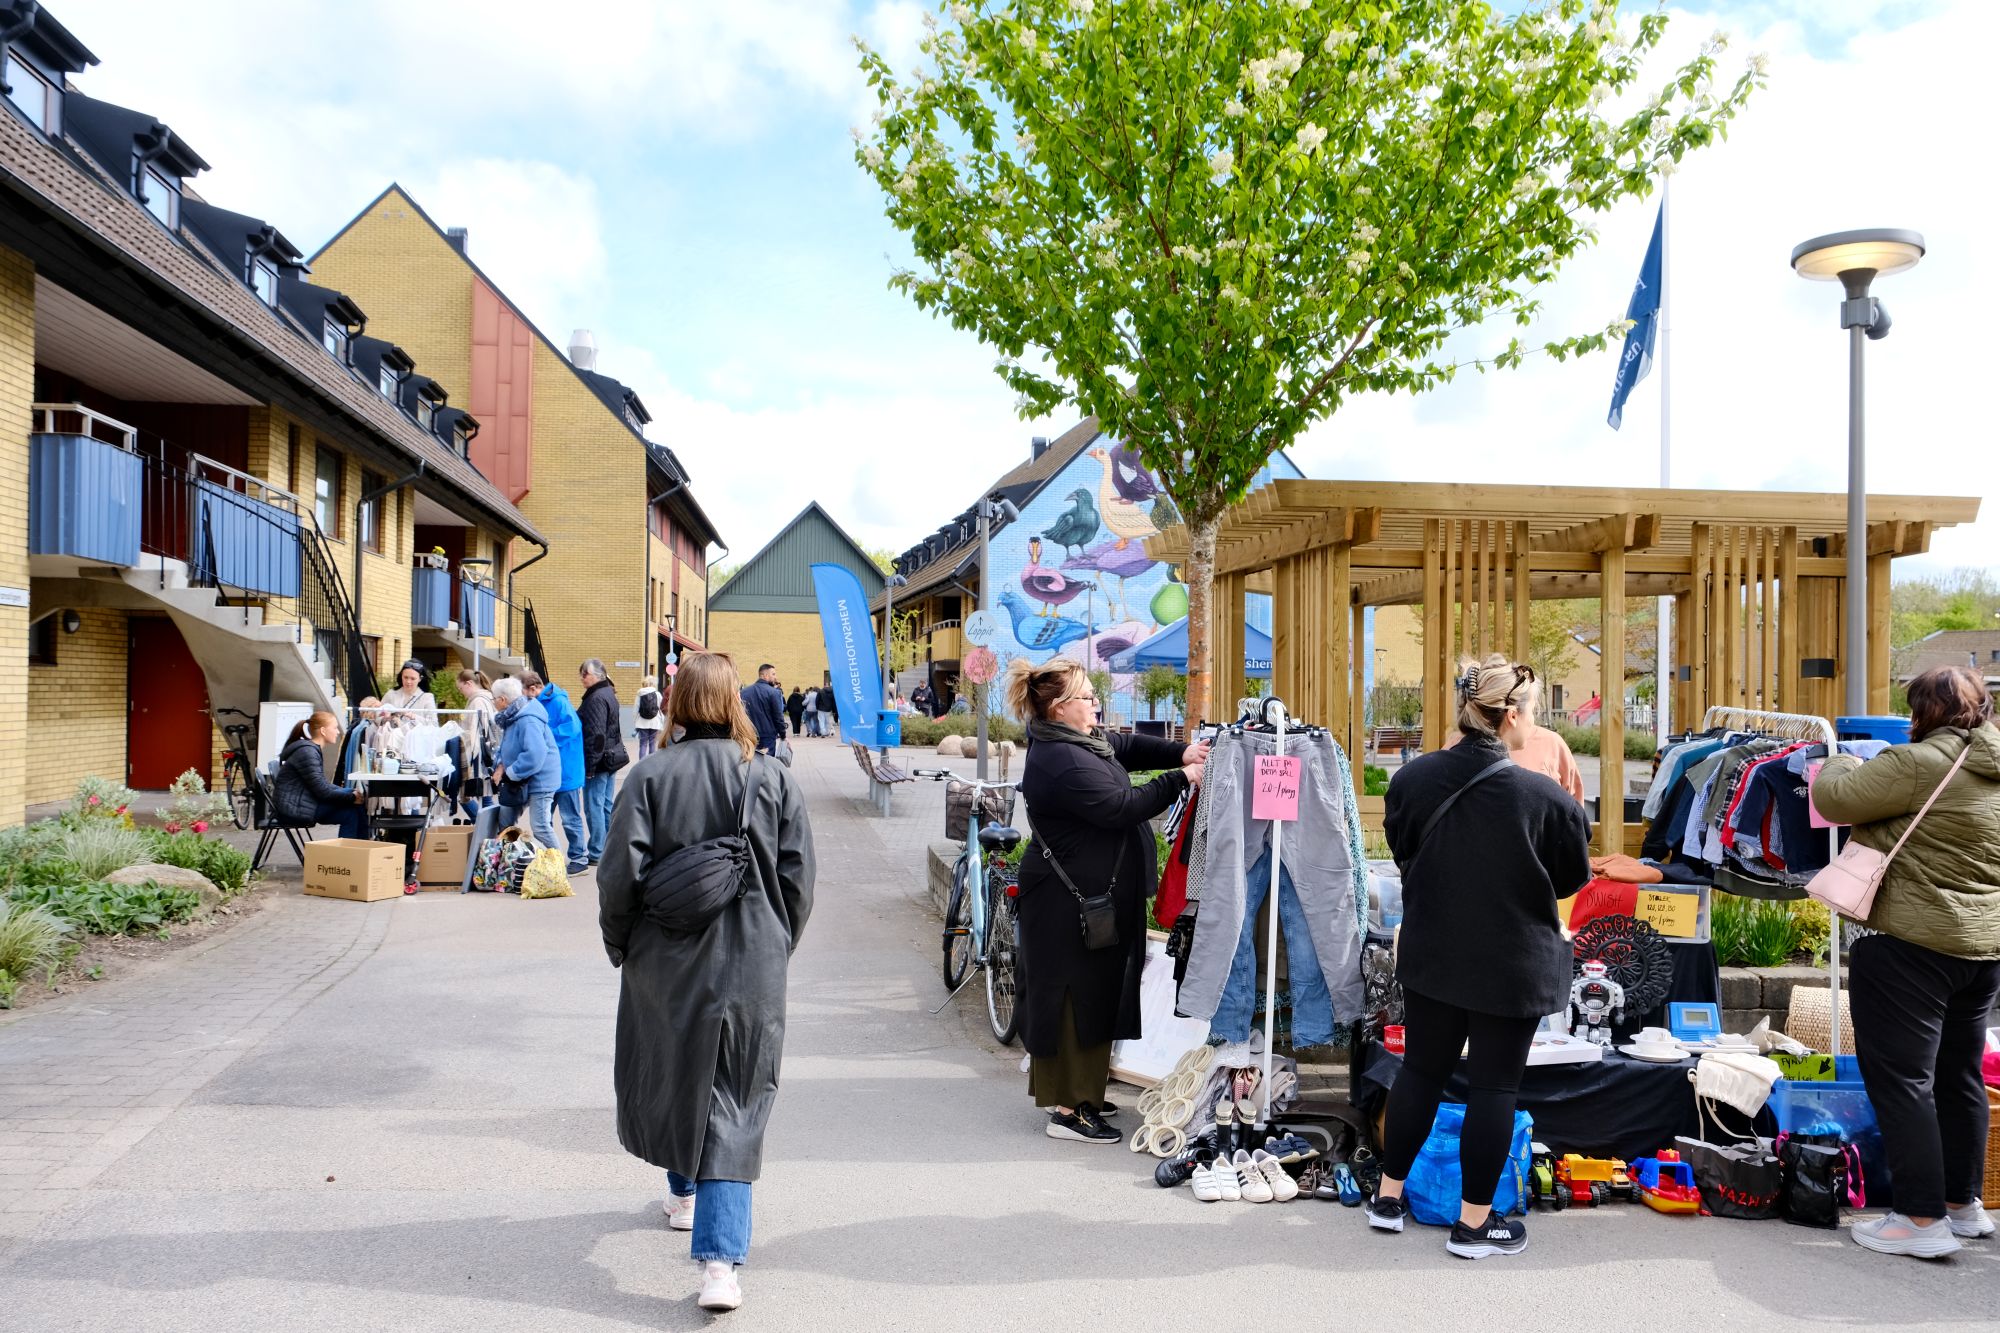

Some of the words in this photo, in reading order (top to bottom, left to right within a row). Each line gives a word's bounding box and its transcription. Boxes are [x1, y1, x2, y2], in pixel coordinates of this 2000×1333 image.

[967, 623, 994, 640] Loppis
[1261, 758, 1281, 767] ALLT
[317, 864, 351, 876] Flyttlåda
[1586, 888, 1624, 909] SWISH
[1487, 1229, 1512, 1239] HOKA
